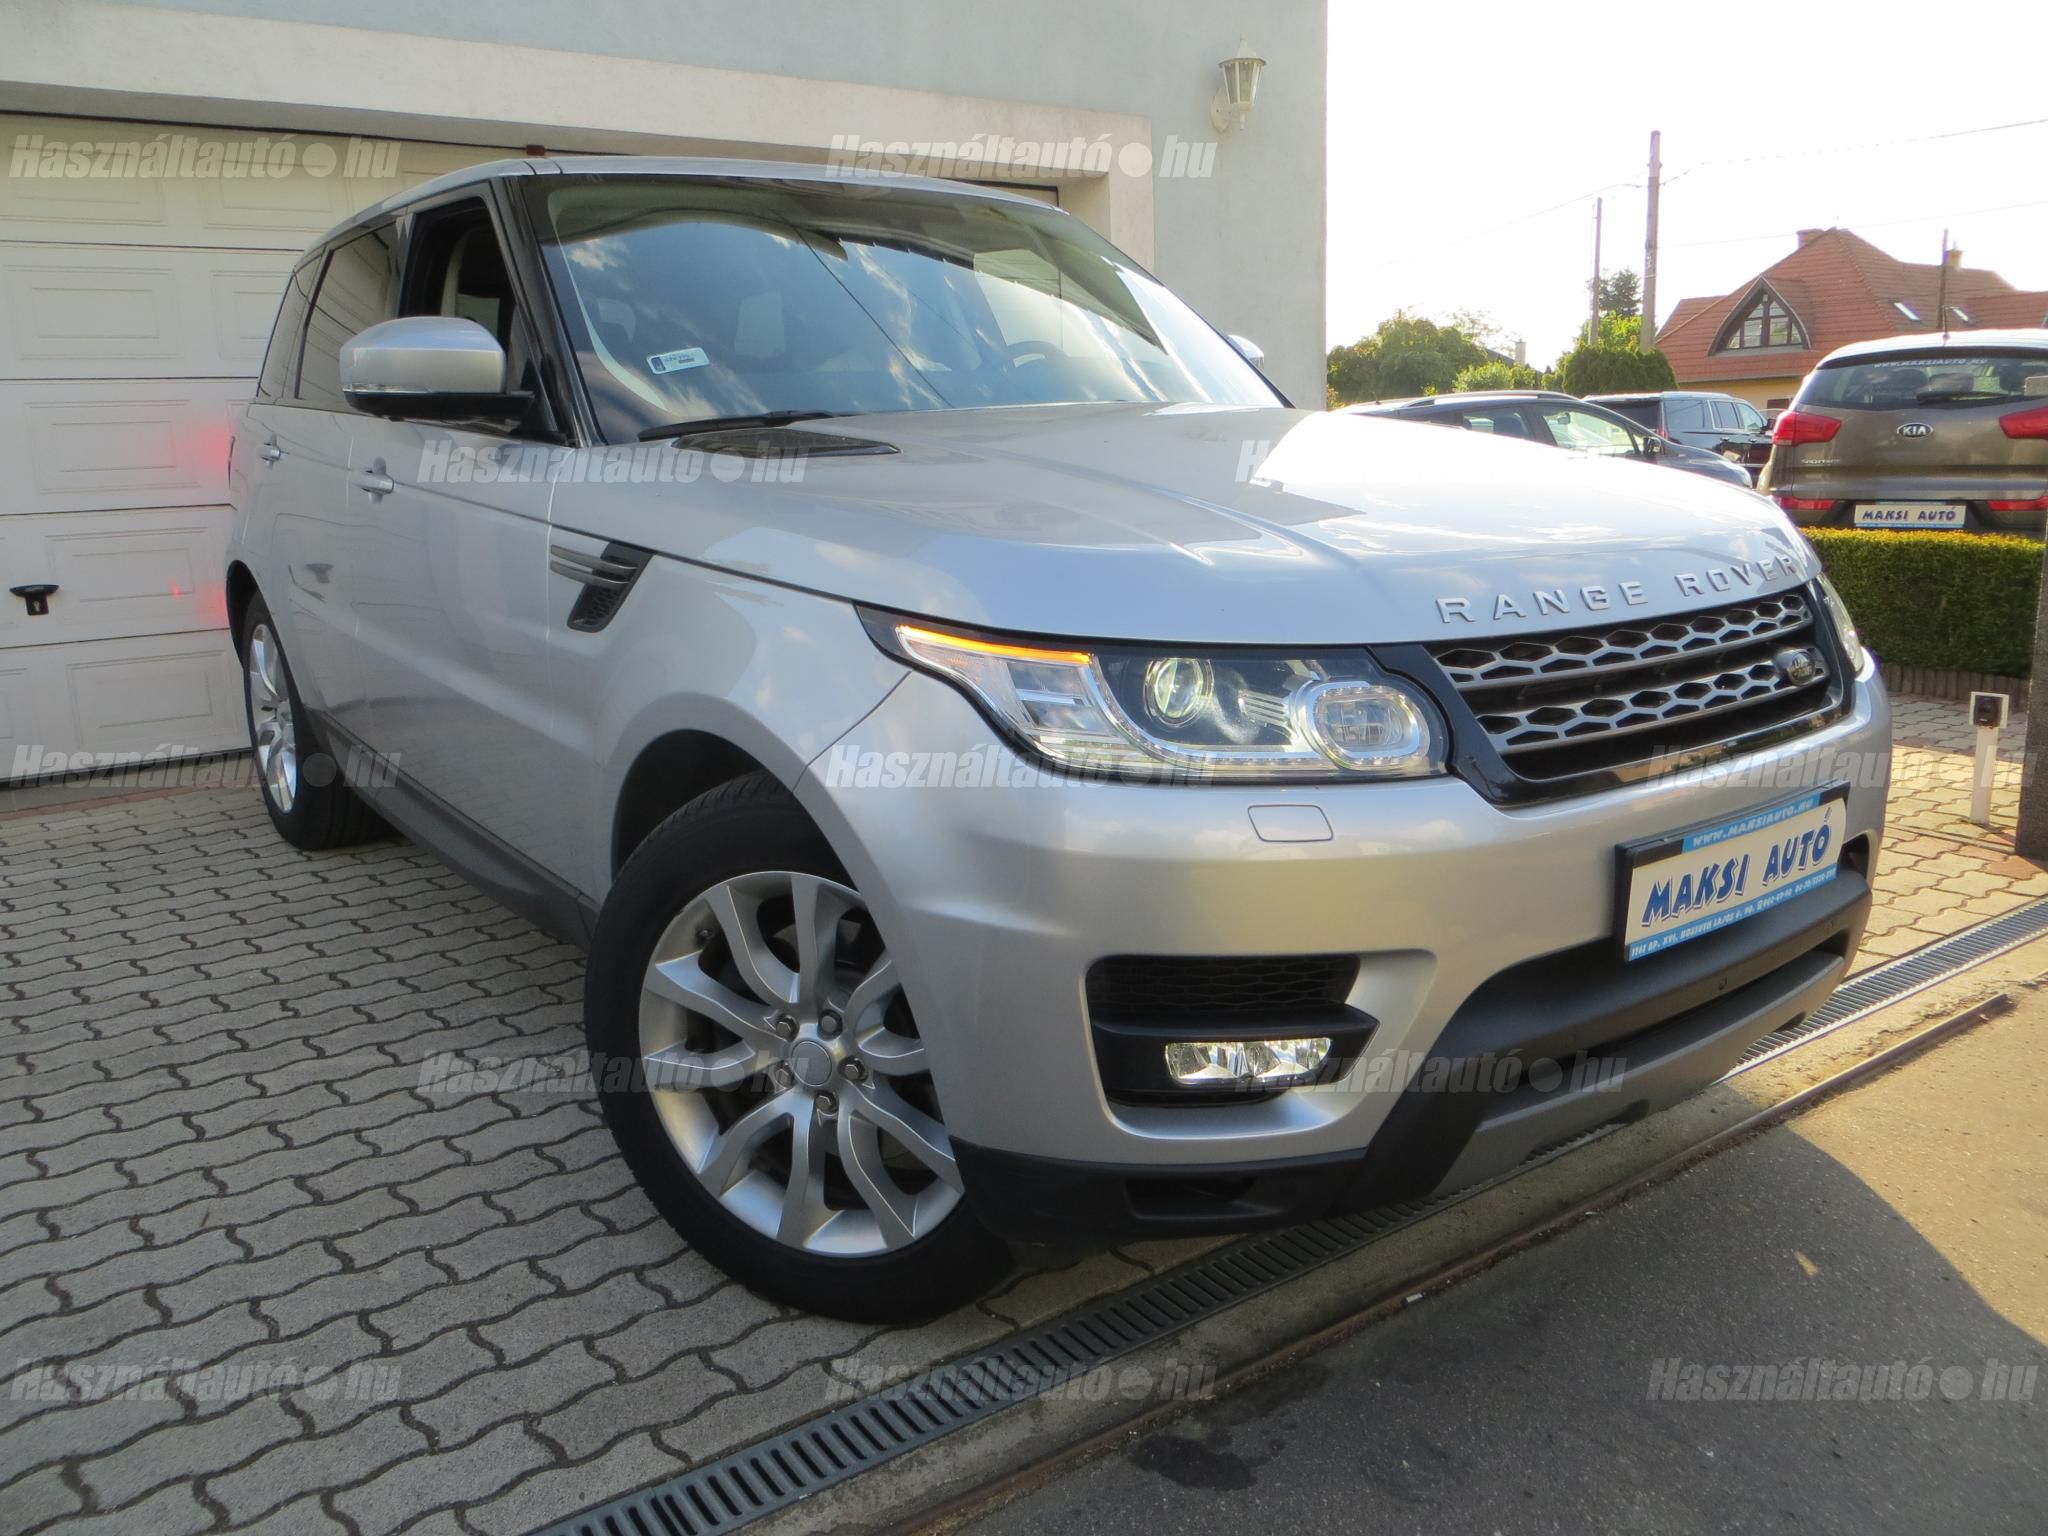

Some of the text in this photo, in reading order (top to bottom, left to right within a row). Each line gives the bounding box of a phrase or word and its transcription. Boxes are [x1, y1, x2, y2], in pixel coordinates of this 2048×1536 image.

[1901, 426, 1927, 437] KIA
[1862, 507, 1956, 521] MAKSI AUTÓ
[1437, 555, 1801, 624] RANGE ROVER
[1692, 798, 1814, 848] WWW.MAKSIAUTO.HU
[1641, 807, 1833, 927] MAKSI AUTÓ
